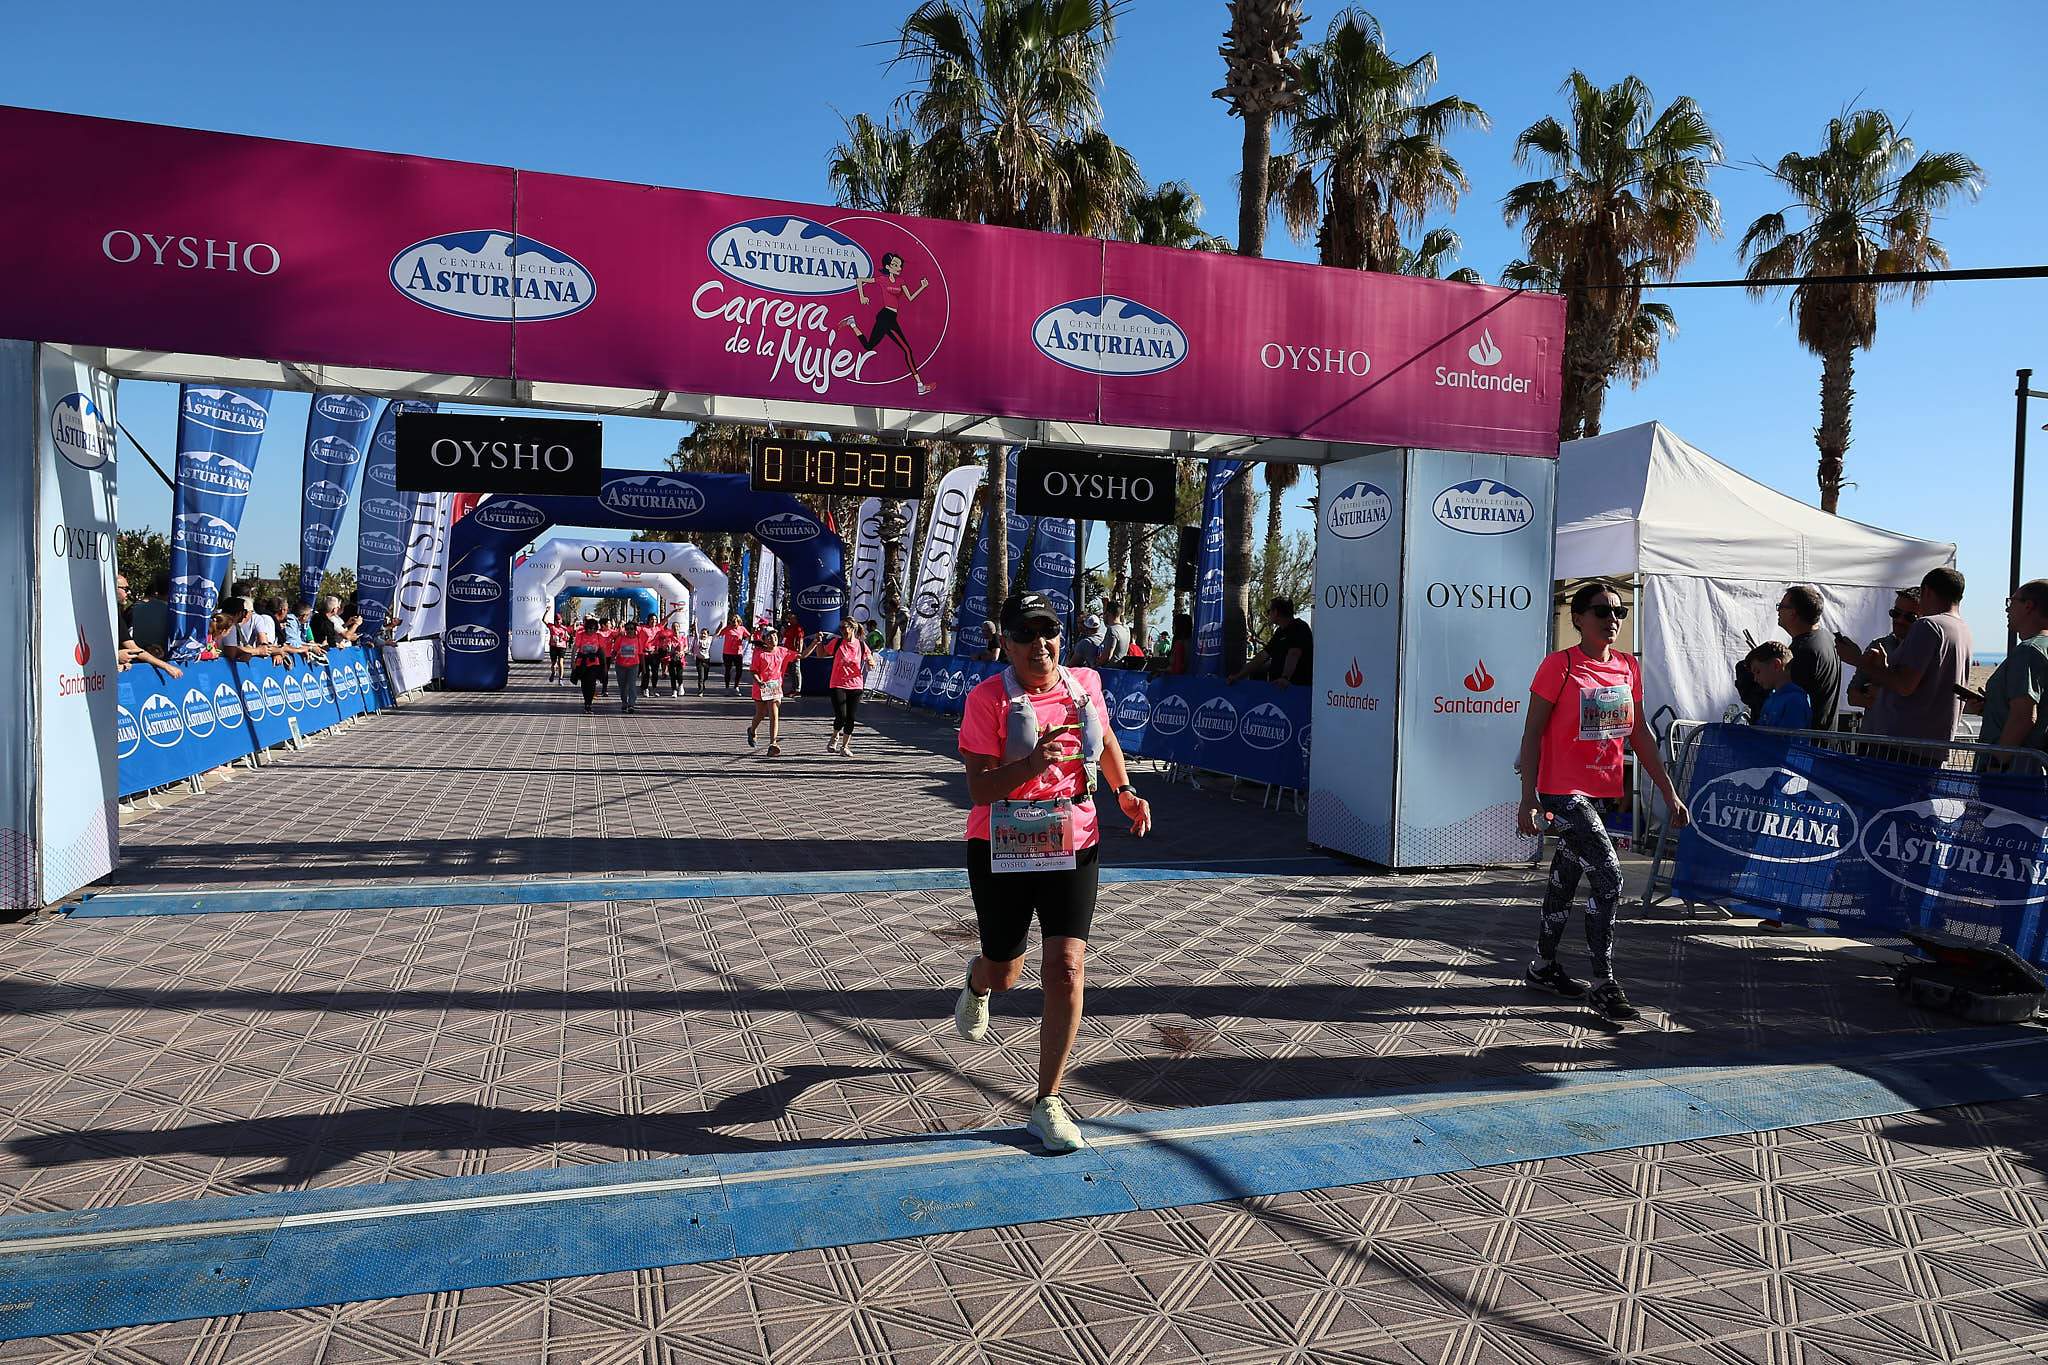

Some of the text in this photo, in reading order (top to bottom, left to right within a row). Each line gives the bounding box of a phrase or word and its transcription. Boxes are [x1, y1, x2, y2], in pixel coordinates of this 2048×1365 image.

[102, 229, 281, 276] OYSHO
[721, 237, 859, 280] ASTURIANA
[747, 238, 856, 258] CENTRAL LECHERA
[439, 256, 503, 271] CENTRAL
[406, 256, 581, 304] ASTURIANA
[691, 280, 829, 331] Carrera
[1044, 319, 1176, 360] ASTURIANA
[1069, 319, 1172, 336] CENTRAL LECHERA
[725, 326, 878, 394] de la Mujer
[1260, 343, 1371, 377] OYSHO
[1434, 366, 1532, 394] Santander
[183, 395, 264, 430] ASTURIANA
[56, 412, 108, 456] ASTURIANA
[431, 438, 574, 473] OYSHO
[605, 486, 698, 510] ASTURIANA
[1043, 471, 1154, 502] OYSHO
[1440, 497, 1527, 523] ASTURIANA
[1455, 497, 1488, 505] CENTRAL
[480, 510, 540, 525] ASTURIANA
[760, 523, 816, 536] ASTURIANA
[1331, 506, 1387, 528] ASTURIANA
[54, 524, 110, 563] OYSHO
[174, 529, 234, 550] STURIANA
[581, 545, 666, 565] OYSHO
[916, 488, 967, 619] OYSHO
[361, 574, 395, 585] STURIANA
[450, 583, 498, 596] ASTURIANA
[1325, 582, 1389, 609] OYSHO
[1426, 582, 1532, 611] OYSHO
[448, 633, 496, 646] ASTURIANA
[59, 670, 106, 698] Santander
[1327, 690, 1380, 712] Santander
[1433, 695, 1521, 714] Santander
[1154, 706, 1186, 726] ASTURIANA
[1194, 710, 1234, 732] ASTURIANA
[1242, 716, 1286, 741] ASTURIANA
[1727, 792, 1841, 819] CENTRAL LECHERA
[1701, 791, 1841, 848] ASTURIANA
[1984, 837, 2048, 854] LECHER
